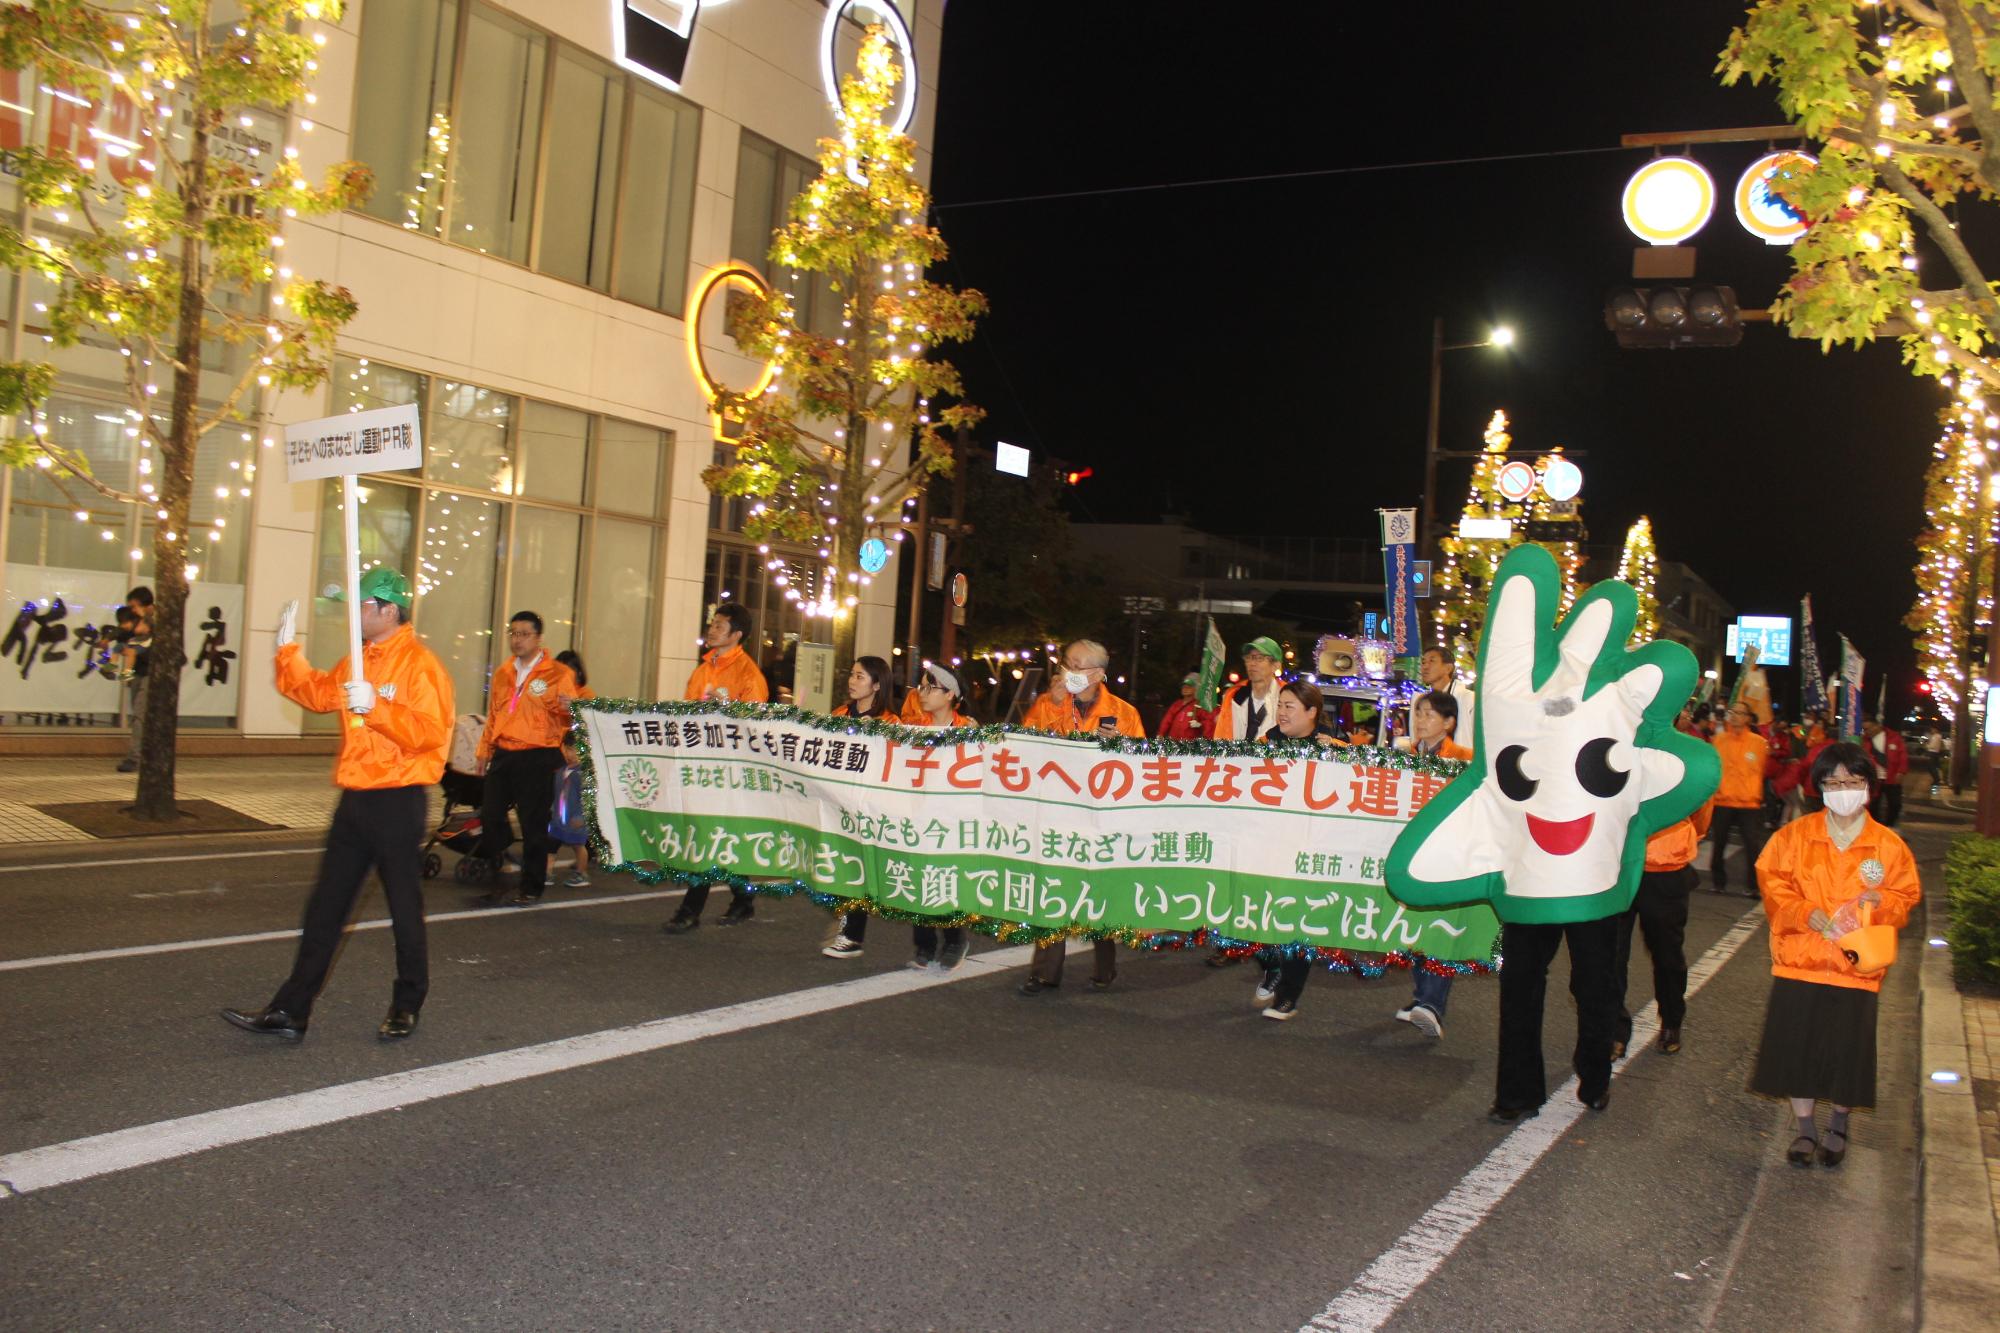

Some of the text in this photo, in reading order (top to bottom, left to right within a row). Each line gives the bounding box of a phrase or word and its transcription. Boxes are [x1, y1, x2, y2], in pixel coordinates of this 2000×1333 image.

[621, 719, 871, 774] 市民総参加子ども育成運動
[680, 763, 809, 799] まなざし運動テーマ
[884, 858, 1106, 922] 笑顔で団らん
